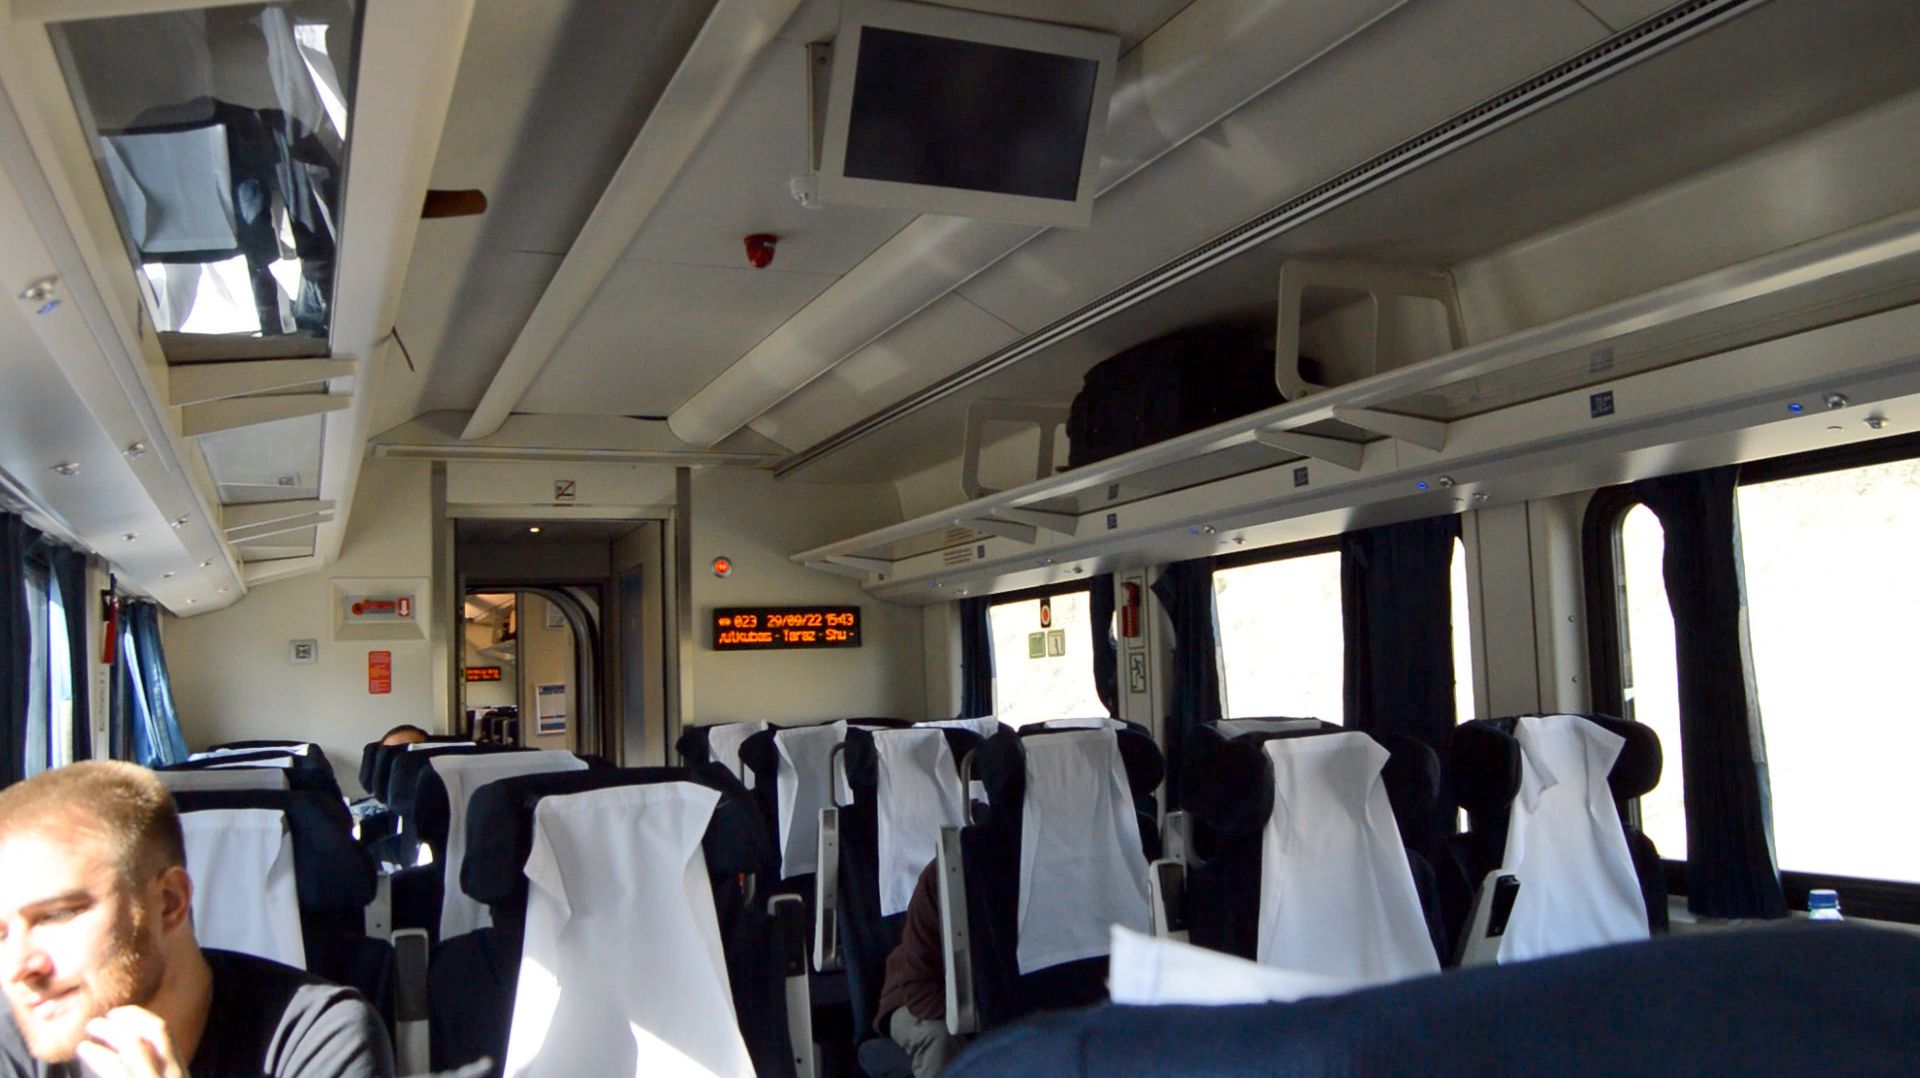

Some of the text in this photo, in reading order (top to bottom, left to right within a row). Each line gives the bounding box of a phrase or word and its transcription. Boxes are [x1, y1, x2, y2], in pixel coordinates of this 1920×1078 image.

[734, 613, 854, 628] 023 29/09/22 15:43
[825, 628, 847, 641] Shu
